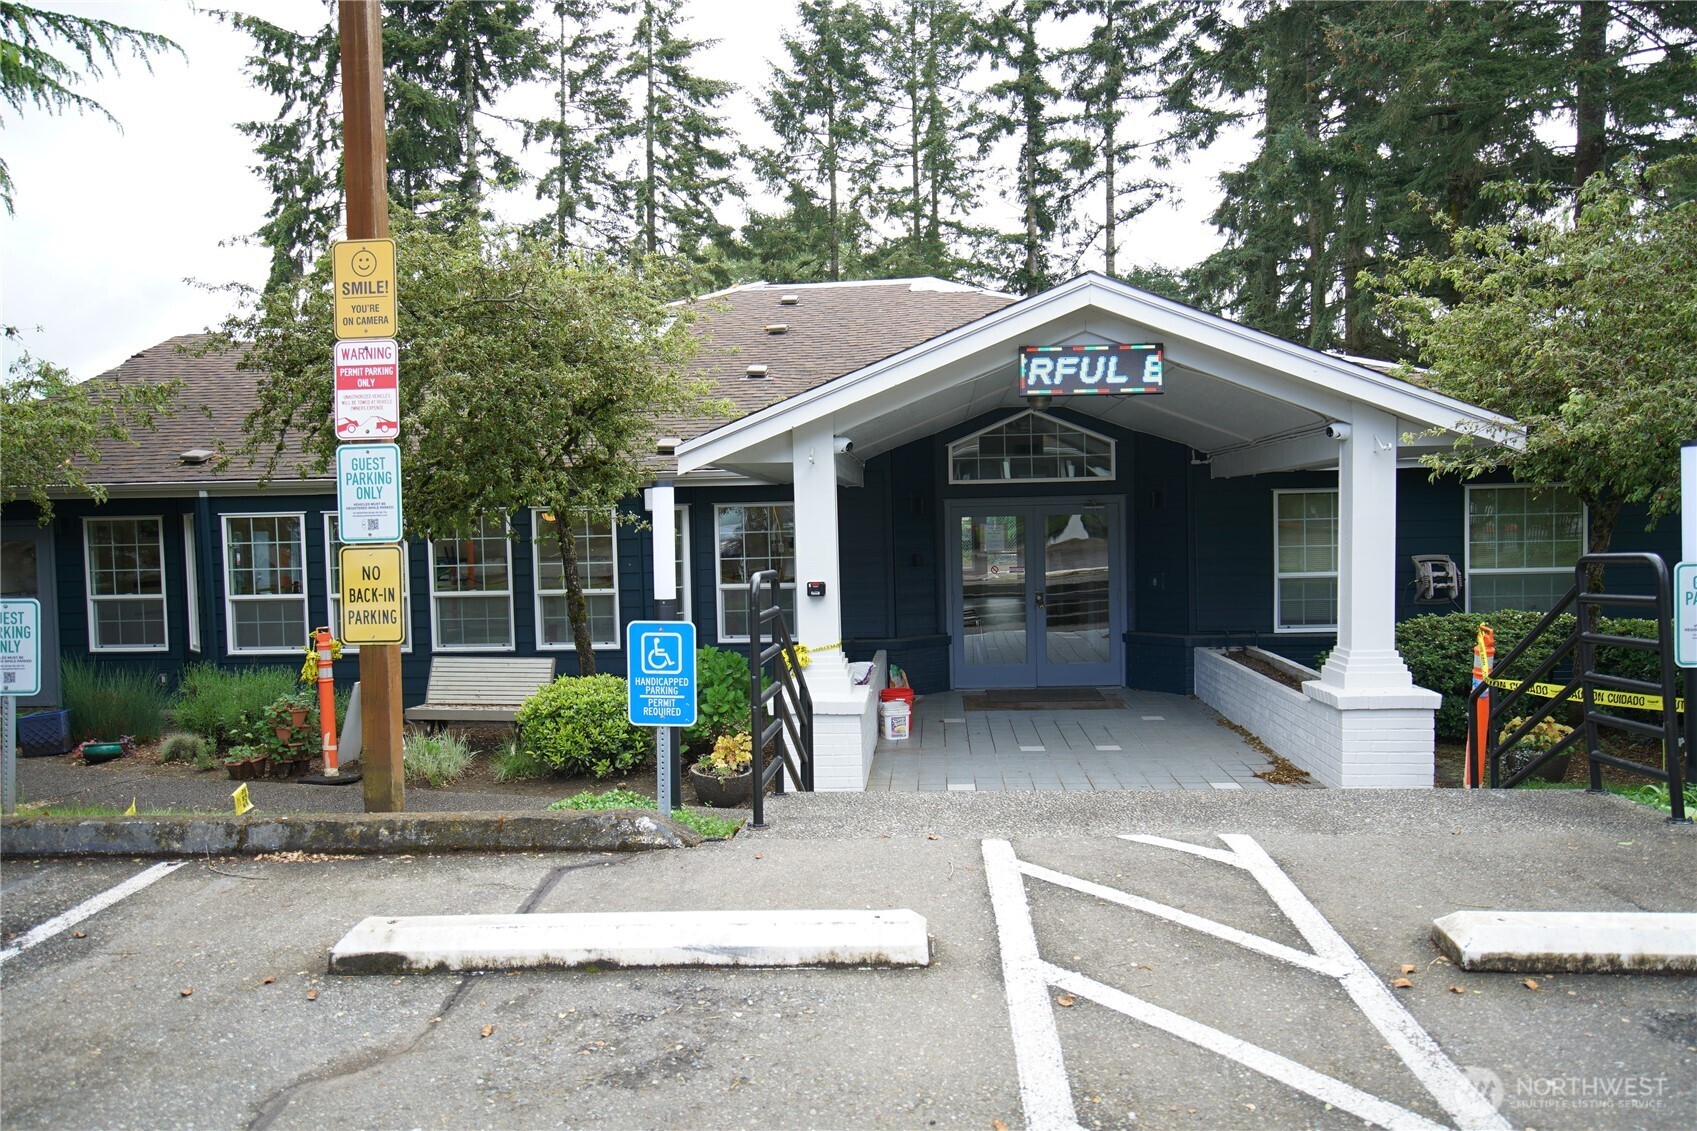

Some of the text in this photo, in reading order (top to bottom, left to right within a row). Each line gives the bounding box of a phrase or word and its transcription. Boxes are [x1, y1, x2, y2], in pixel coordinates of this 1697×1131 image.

[342, 280, 388, 296] SMILE!
[351, 304, 380, 314] YOU'RE
[342, 316, 388, 326] ON CAMERA
[341, 346, 392, 361] WARNING
[340, 366, 394, 376] PERMIT PARKING
[1026, 356, 1128, 385] RFUL
[357, 378, 375, 388] ONLY
[351, 456, 386, 471] GUEST
[346, 472, 392, 486] PARKING
[356, 486, 382, 500] ONLY
[362, 566, 381, 581] NO
[350, 588, 395, 603] BACK-IN
[348, 609, 397, 625] PARKING
[635, 677, 689, 686] HANDICAPPED
[1608, 693, 1645, 706] CUIDADO
[643, 707, 681, 716] REQUIRED
